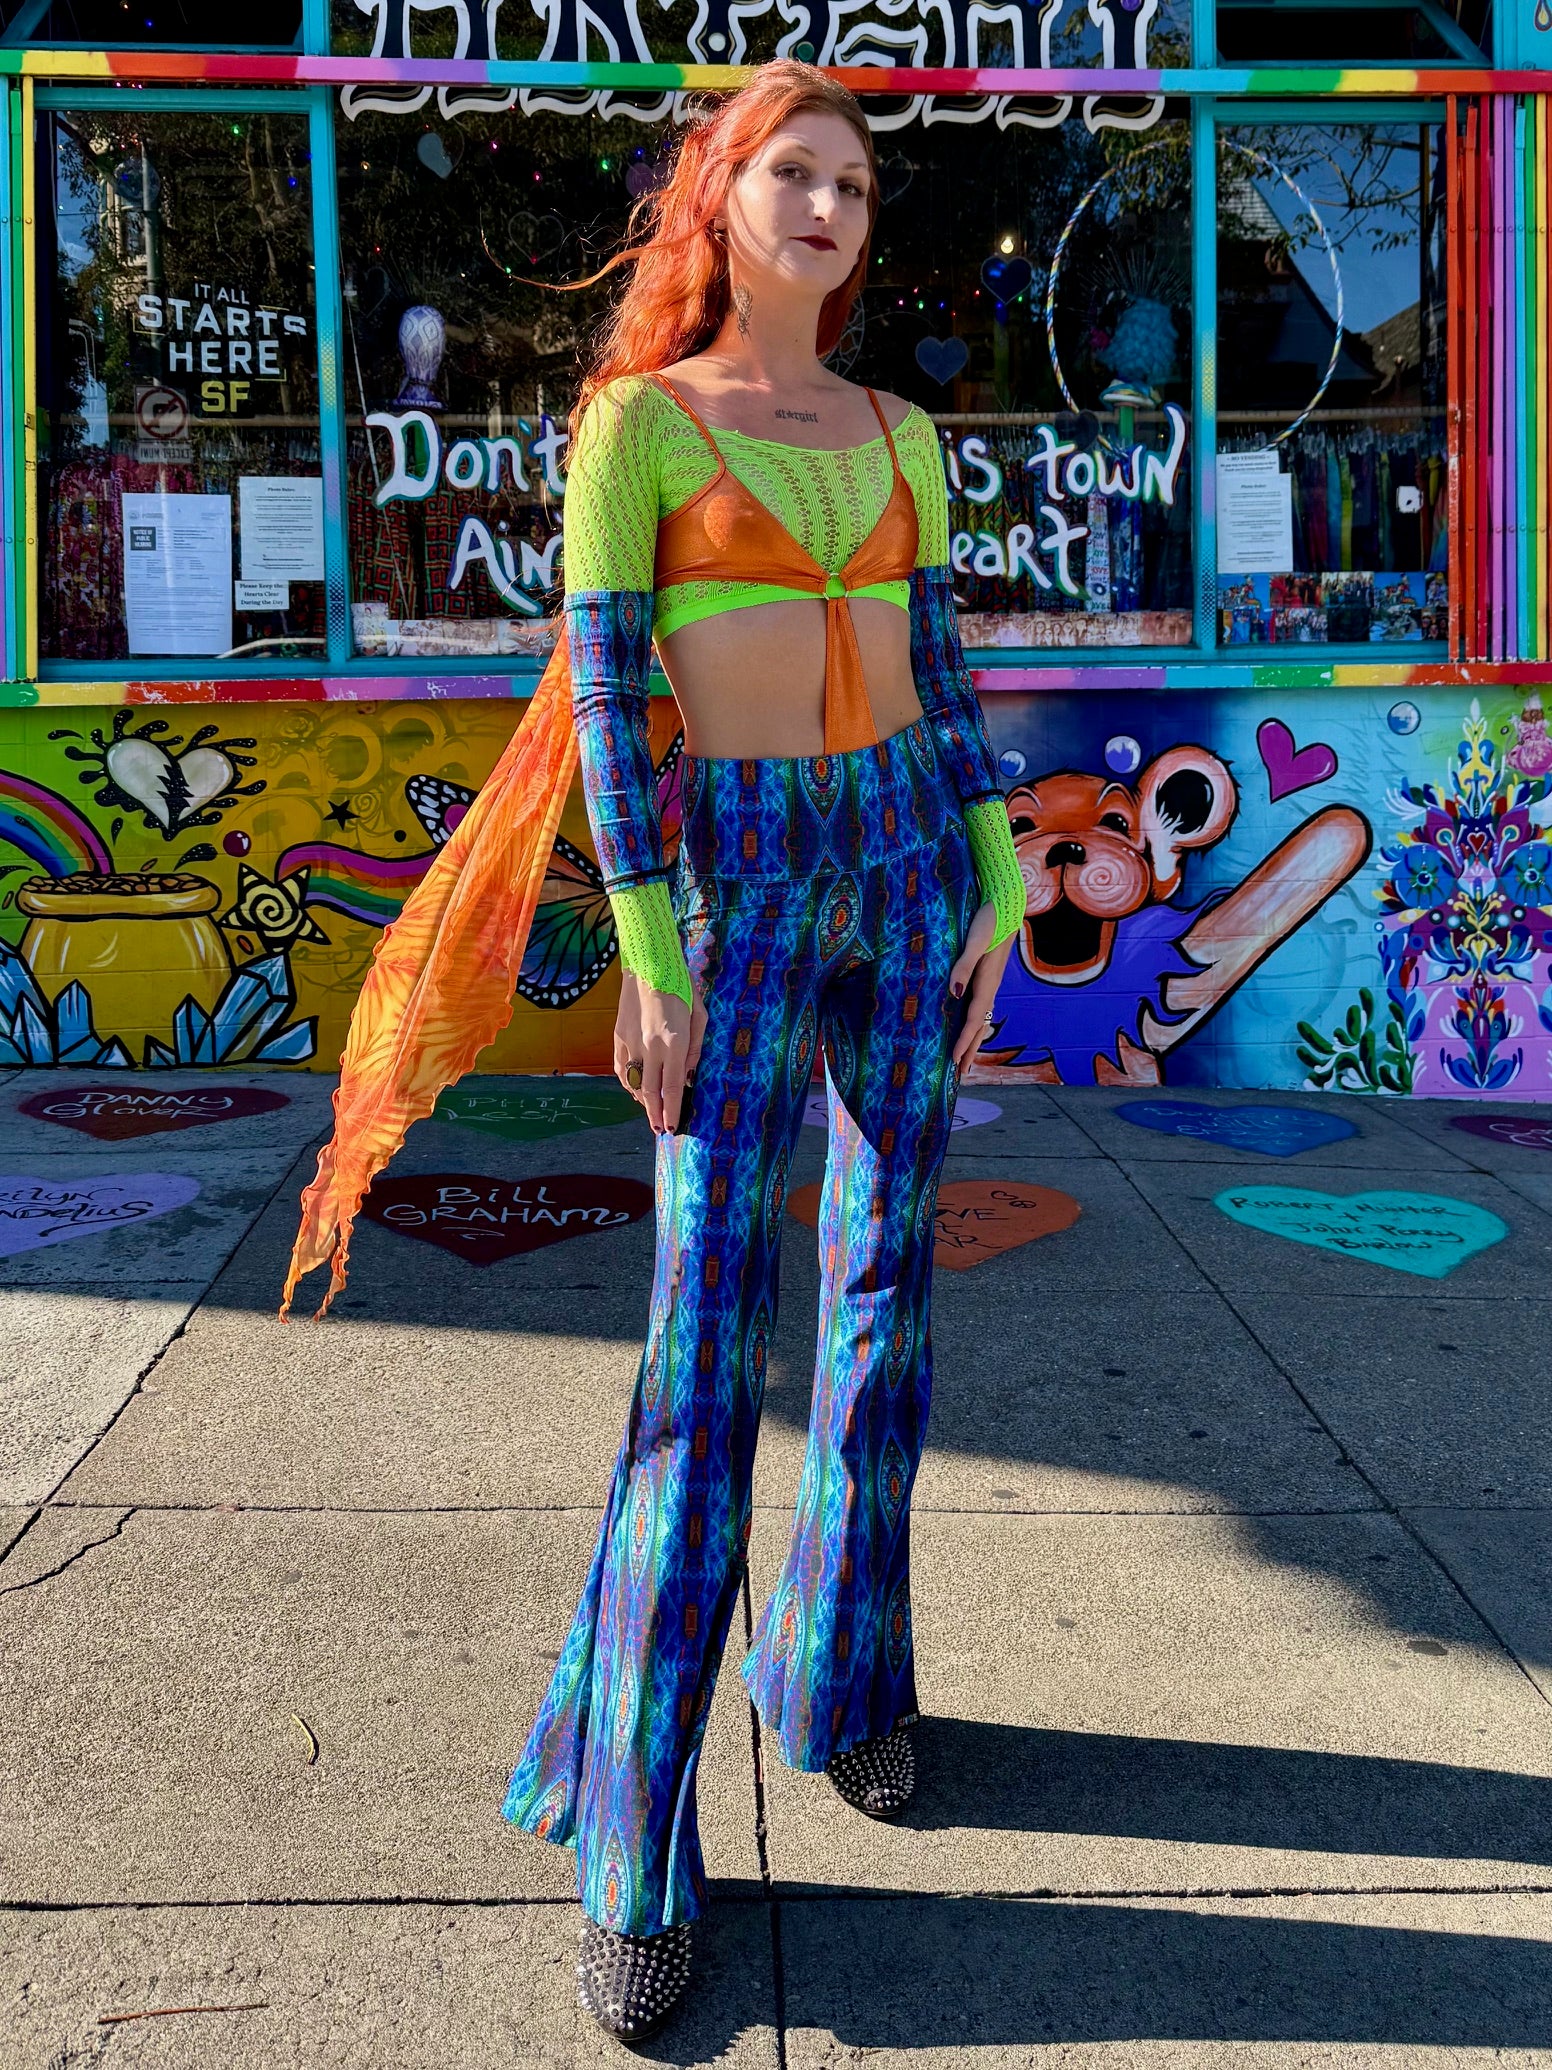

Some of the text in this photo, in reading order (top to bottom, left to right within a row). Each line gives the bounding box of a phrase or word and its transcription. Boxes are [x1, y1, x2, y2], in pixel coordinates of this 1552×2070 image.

[194, 283, 250, 305] IT ALL
[138, 294, 307, 336] STARTS
[168, 340, 280, 375] HERE
[201, 380, 250, 413] SF
